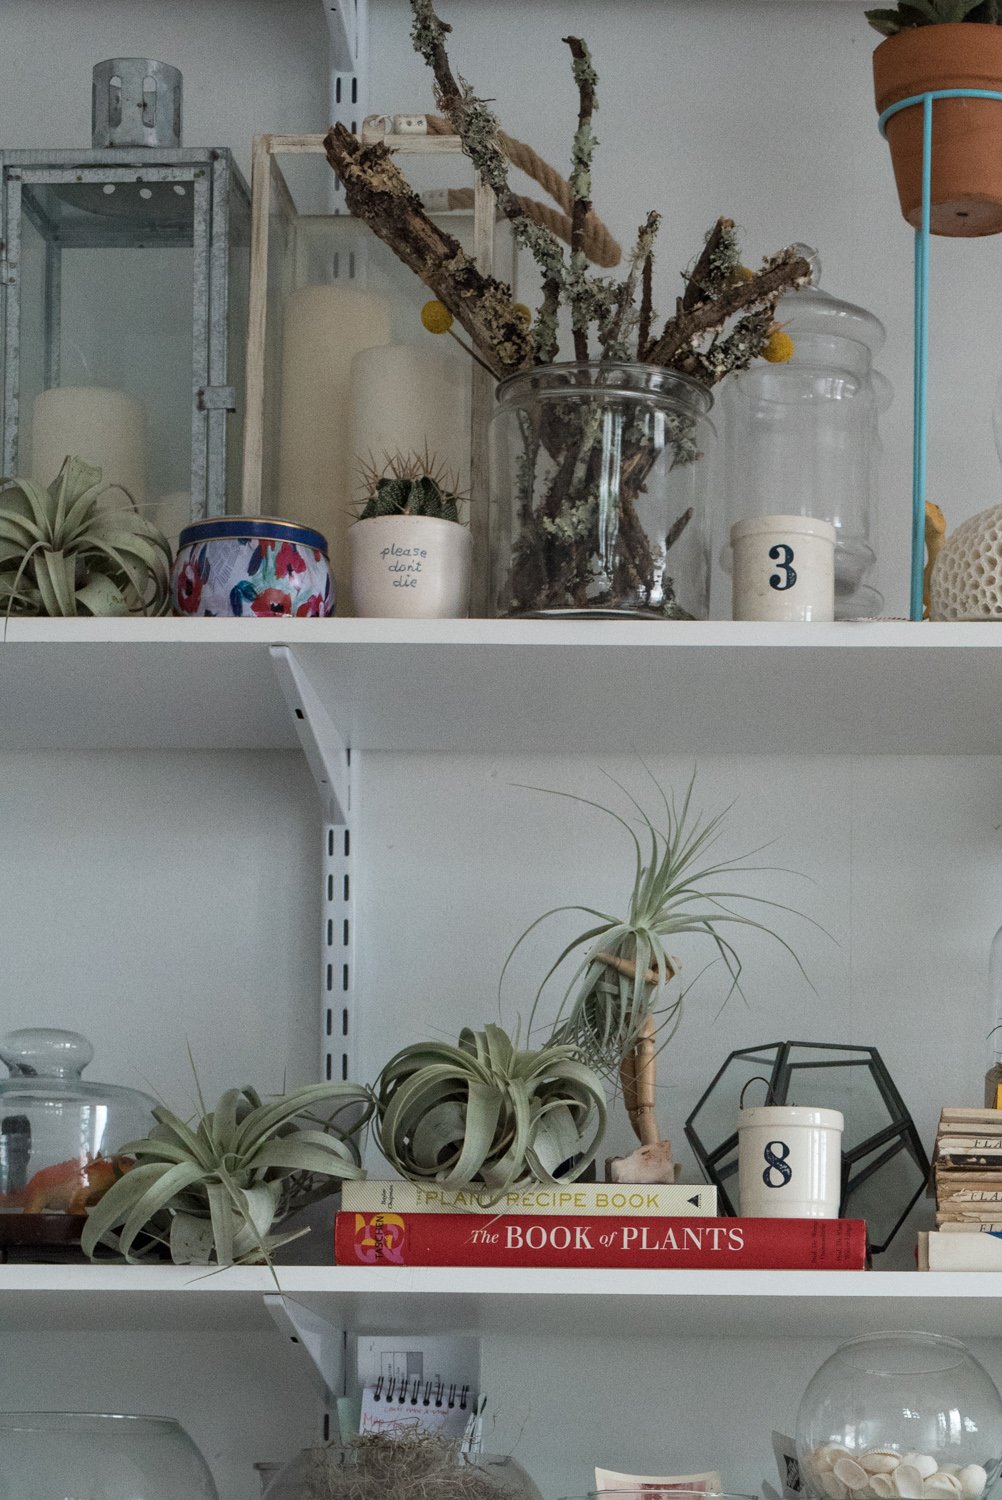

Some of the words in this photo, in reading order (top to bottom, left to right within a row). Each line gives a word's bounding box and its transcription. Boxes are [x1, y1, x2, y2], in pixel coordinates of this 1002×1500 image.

[380, 543, 428, 560] please
[388, 559, 422, 573] don't
[768, 544, 797, 591] 3
[392, 574, 418, 588] die
[762, 1141, 792, 1188] 8
[506, 1192, 587, 1208] RECIPE
[596, 1193, 660, 1209] BOOK
[375, 1215, 384, 1260] TASCHEN
[471, 1230, 500, 1244] The
[505, 1226, 594, 1250] BOOK
[600, 1232, 617, 1247] of
[620, 1226, 745, 1251] PLANTS
